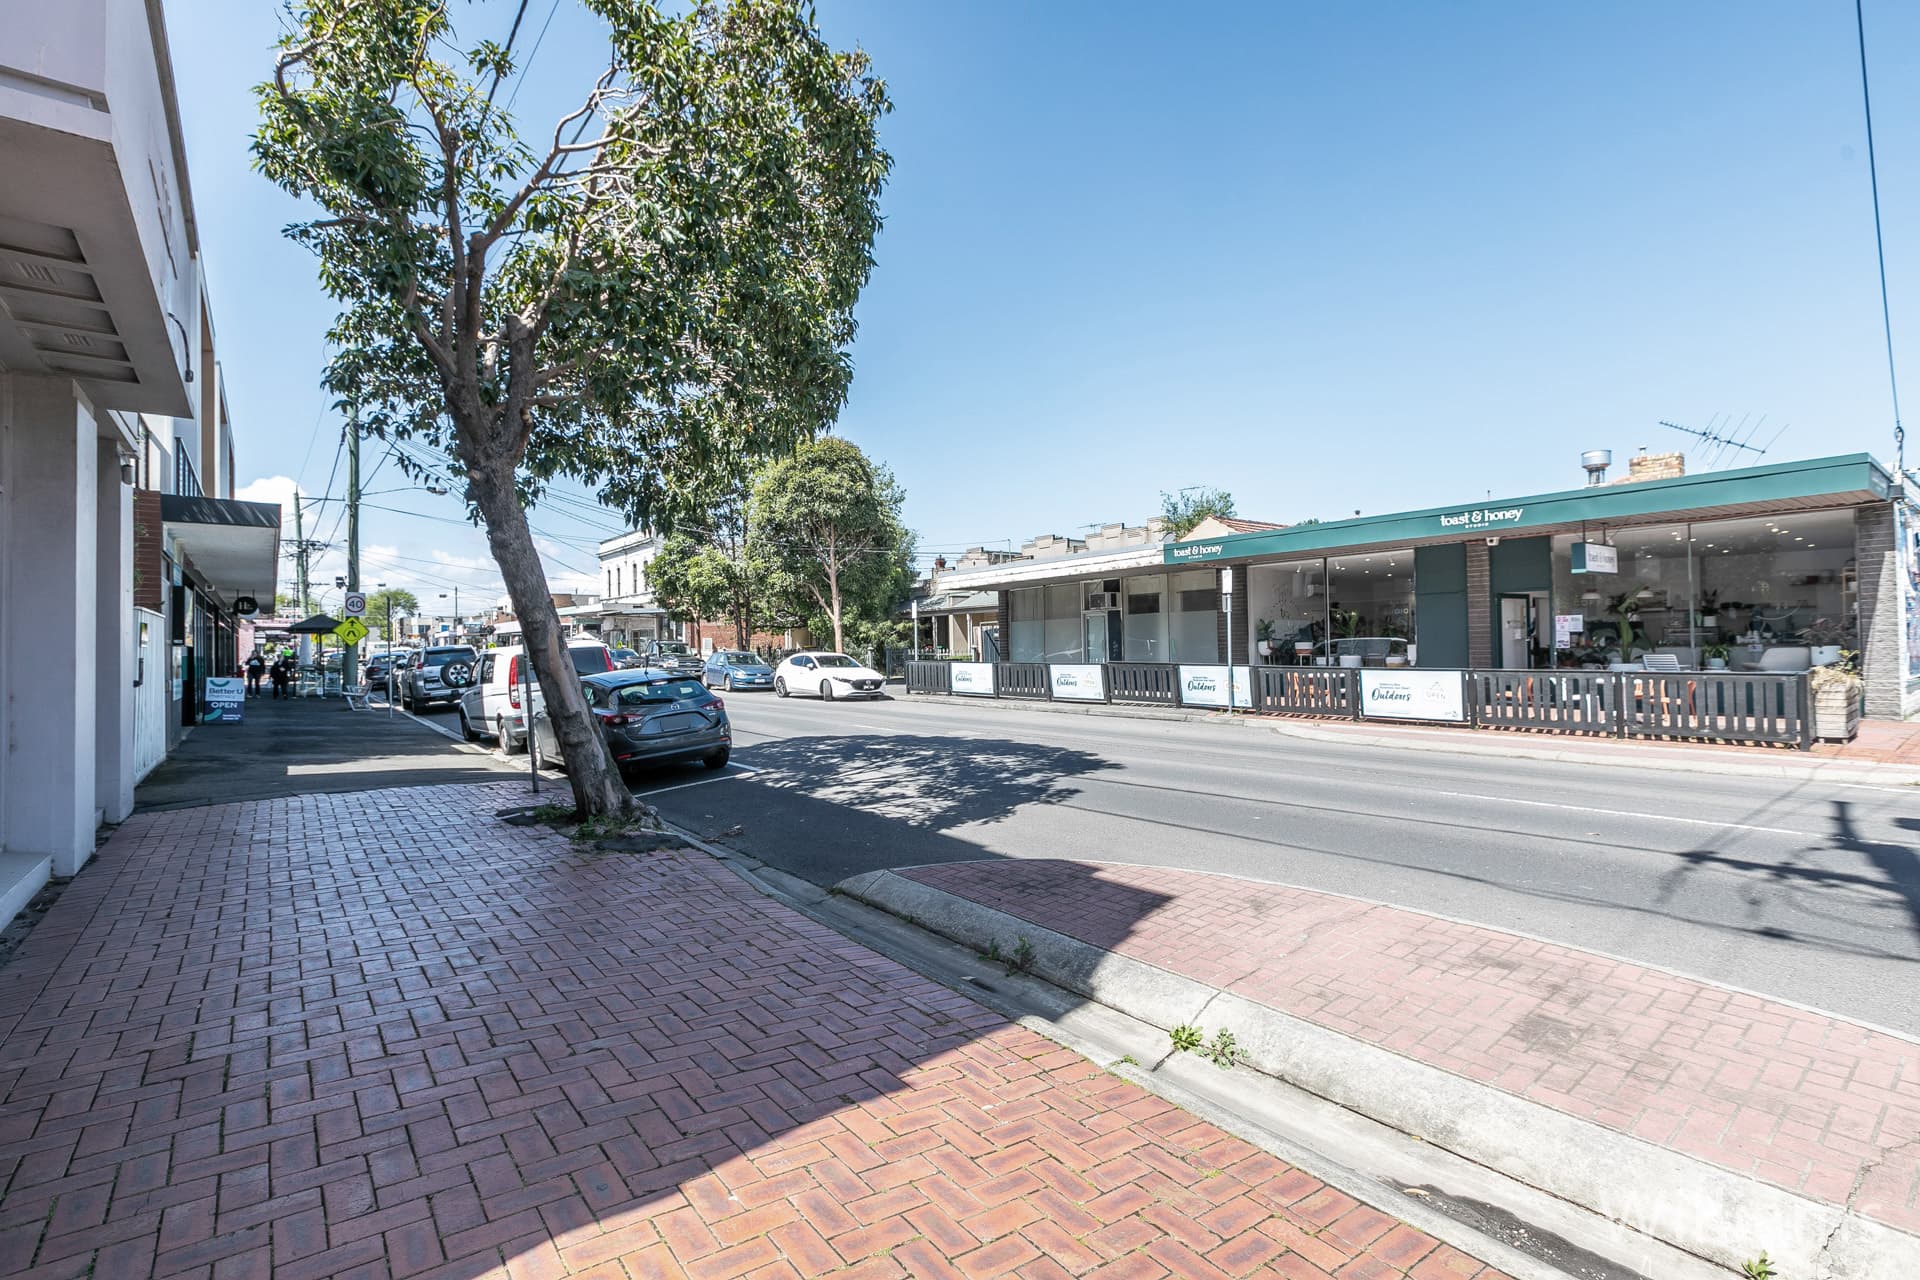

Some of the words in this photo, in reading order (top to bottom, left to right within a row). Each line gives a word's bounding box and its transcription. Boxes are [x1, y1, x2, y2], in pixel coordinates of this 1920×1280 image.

[1440, 512, 1470, 527] toast
[1471, 511, 1482, 523] &
[1484, 508, 1524, 522] honey
[1174, 547, 1191, 557] toast
[1191, 545, 1198, 555] &
[1200, 545, 1223, 555] honey
[349, 600, 363, 609] 40
[1371, 688, 1411, 702] Outdoors
